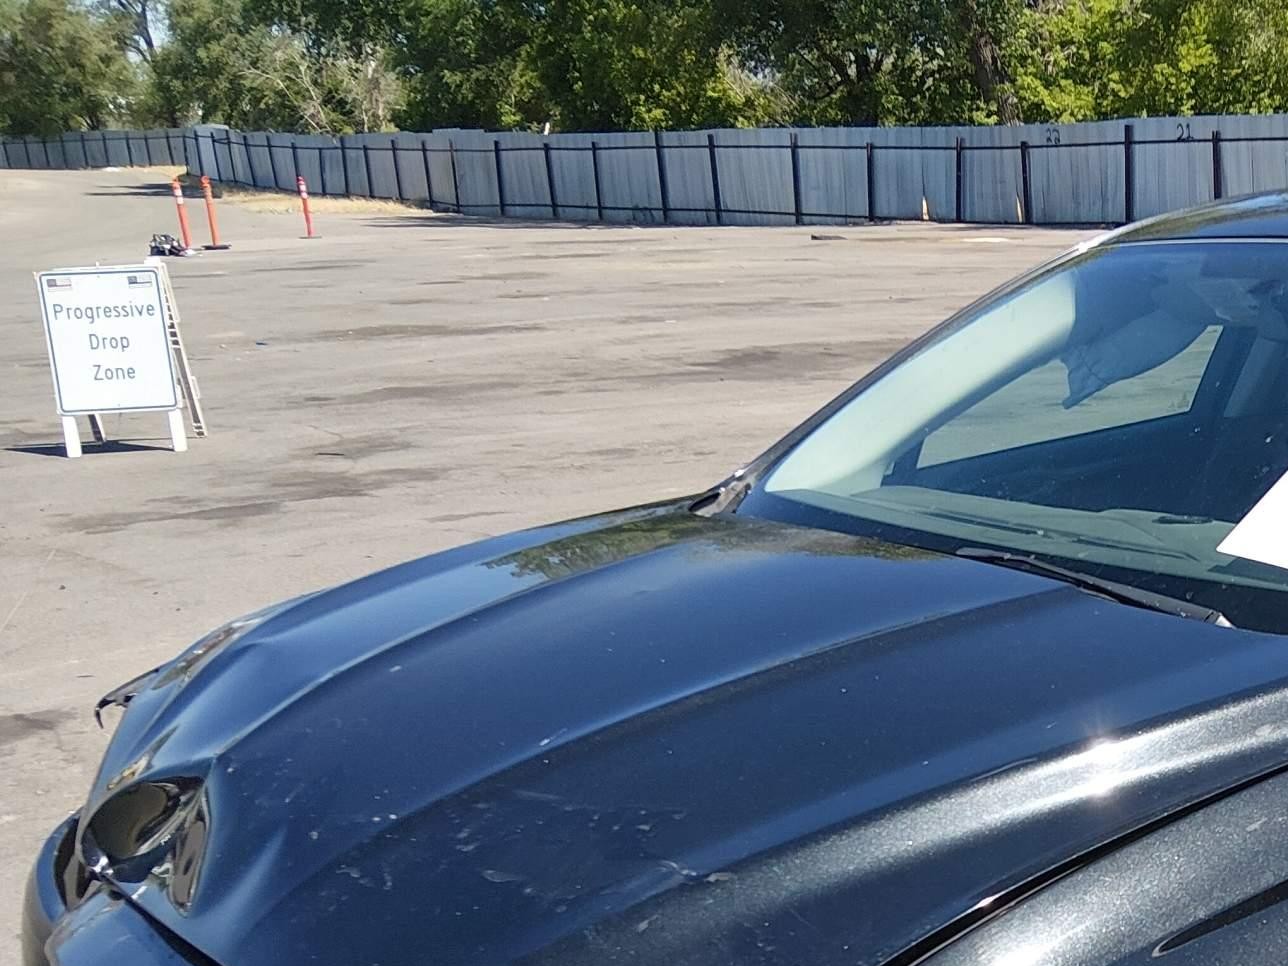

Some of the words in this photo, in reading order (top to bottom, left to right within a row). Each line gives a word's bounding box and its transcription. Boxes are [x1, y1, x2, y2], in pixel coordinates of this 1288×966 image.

[1176, 123, 1194, 140] 21
[52, 300, 155, 324] Progressive
[88, 333, 130, 352] Drop
[92, 364, 136, 381] Zone
